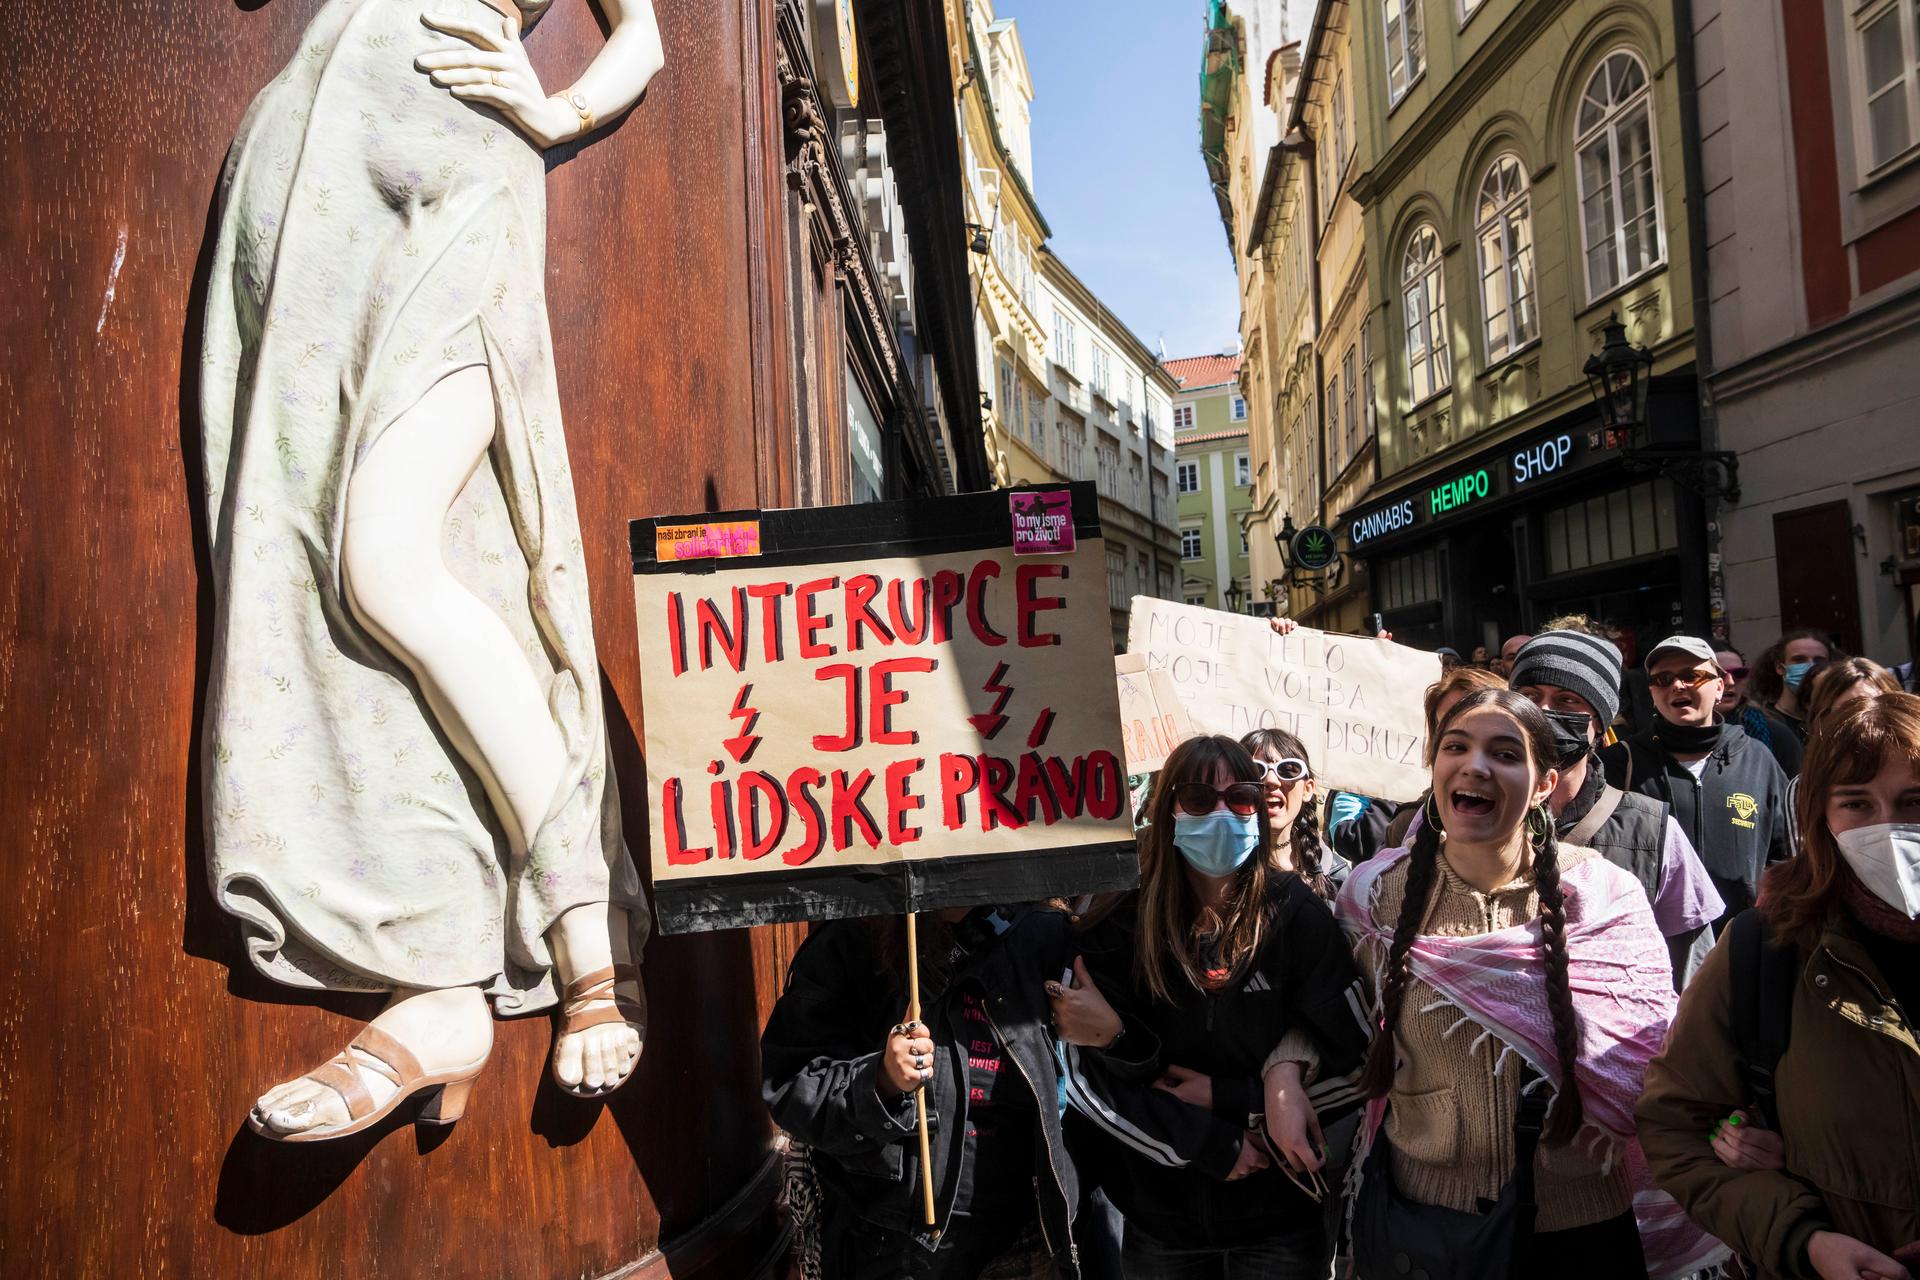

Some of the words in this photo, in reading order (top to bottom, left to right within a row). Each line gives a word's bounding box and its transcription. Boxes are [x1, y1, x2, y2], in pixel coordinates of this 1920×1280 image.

[1352, 499, 1413, 543] CANNABIS
[1431, 469, 1489, 515] HEMPO
[1514, 434, 1571, 483] SHOP
[1015, 513, 1026, 528] To
[1026, 513, 1041, 530] my
[1016, 529, 1034, 542] pro
[1034, 526, 1061, 541] život!
[667, 559, 1070, 678] INTERUPCE
[1149, 612, 1237, 656] MOJE
[812, 656, 939, 752] JE
[1148, 651, 1232, 689] MOJE
[1264, 667, 1366, 709] VOLBA
[939, 707, 1125, 833] PRÁVO
[970, 1039, 993, 1054] JEST
